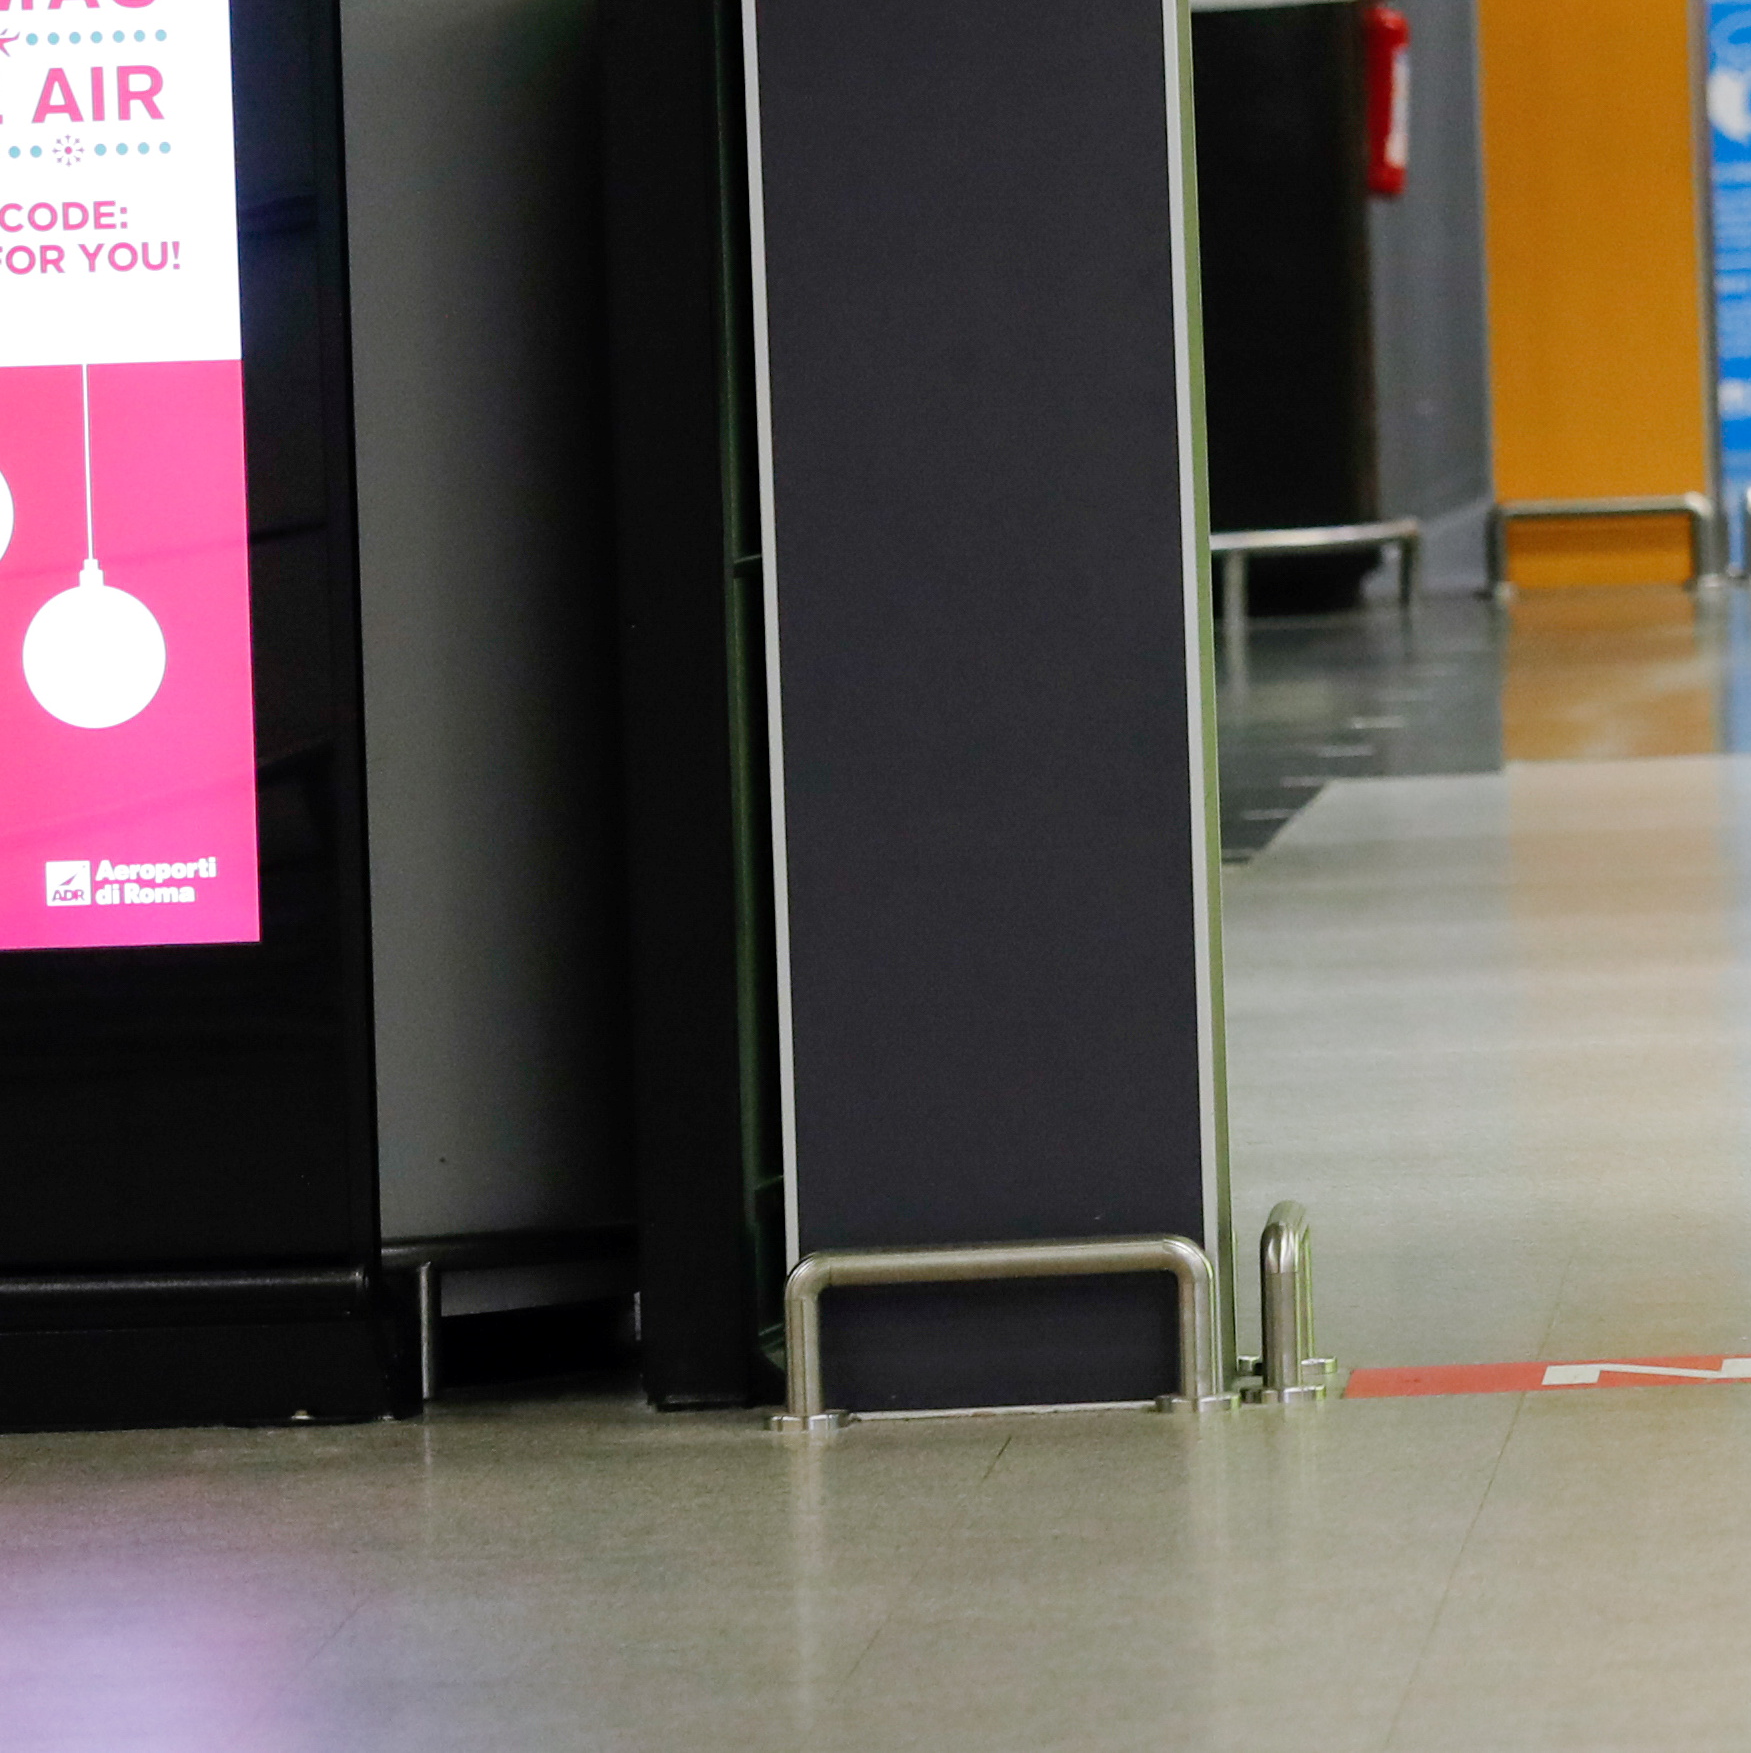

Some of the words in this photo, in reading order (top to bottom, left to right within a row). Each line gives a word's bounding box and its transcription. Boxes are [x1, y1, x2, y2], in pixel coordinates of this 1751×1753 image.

[31, 65, 165, 124] AIR
[0, 200, 128, 233] CODE:
[78, 241, 180, 273] YOU!
[95, 856, 217, 884] Aeroporti
[52, 888, 85, 902] ADR
[95, 883, 121, 905] di
[124, 882, 196, 904] Roma
